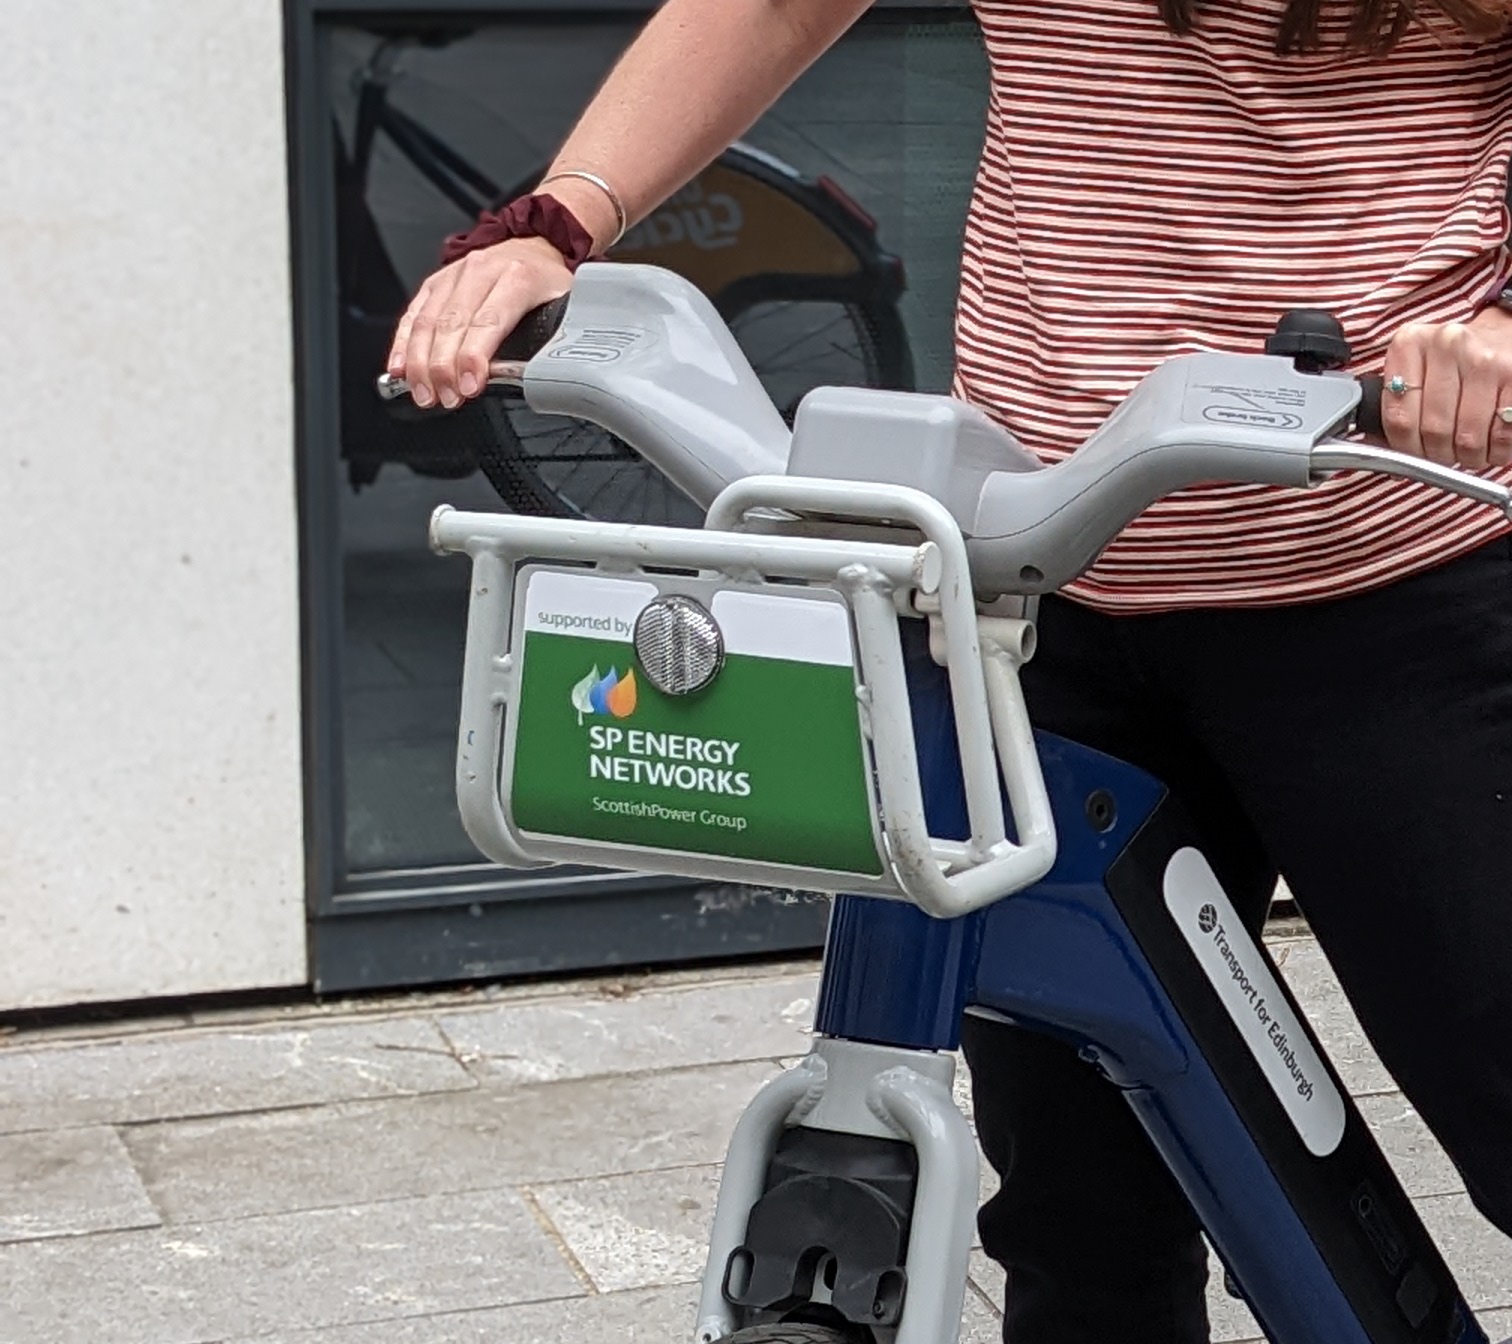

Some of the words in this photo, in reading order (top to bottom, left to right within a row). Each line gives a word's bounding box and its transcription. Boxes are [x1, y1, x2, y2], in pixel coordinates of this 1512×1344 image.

[538, 610, 612, 633] supported
[614, 618, 633, 637] by
[589, 725, 623, 751] SP
[627, 729, 741, 766] ENERGY
[590, 753, 751, 797] NETWORKS
[592, 796, 697, 823] ScottishPower
[700, 808, 747, 832] Group
[1212, 924, 1258, 1005] Transport
[1253, 998, 1272, 1026] for
[1267, 1020, 1314, 1102] Edinburgh
